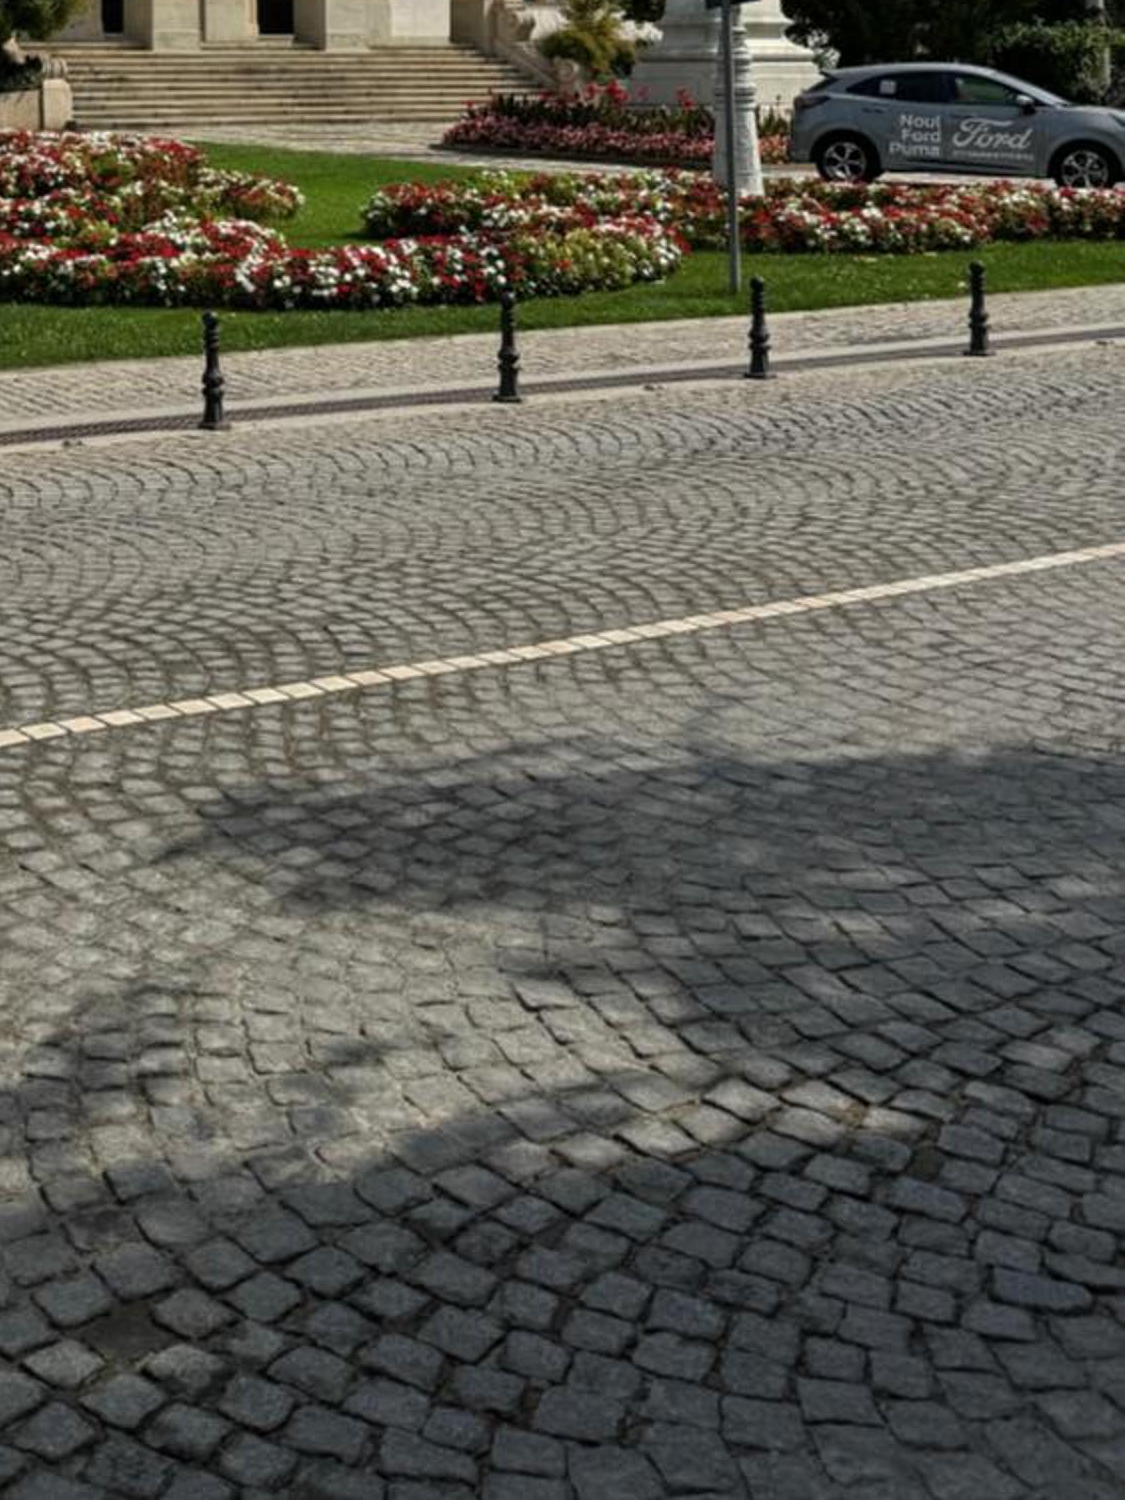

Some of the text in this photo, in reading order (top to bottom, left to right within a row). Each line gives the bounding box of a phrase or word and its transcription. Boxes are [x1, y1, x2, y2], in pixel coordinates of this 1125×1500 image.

[901, 127, 941, 142] Ford
[952, 117, 1033, 150] Ford
[889, 141, 941, 157] Puma
